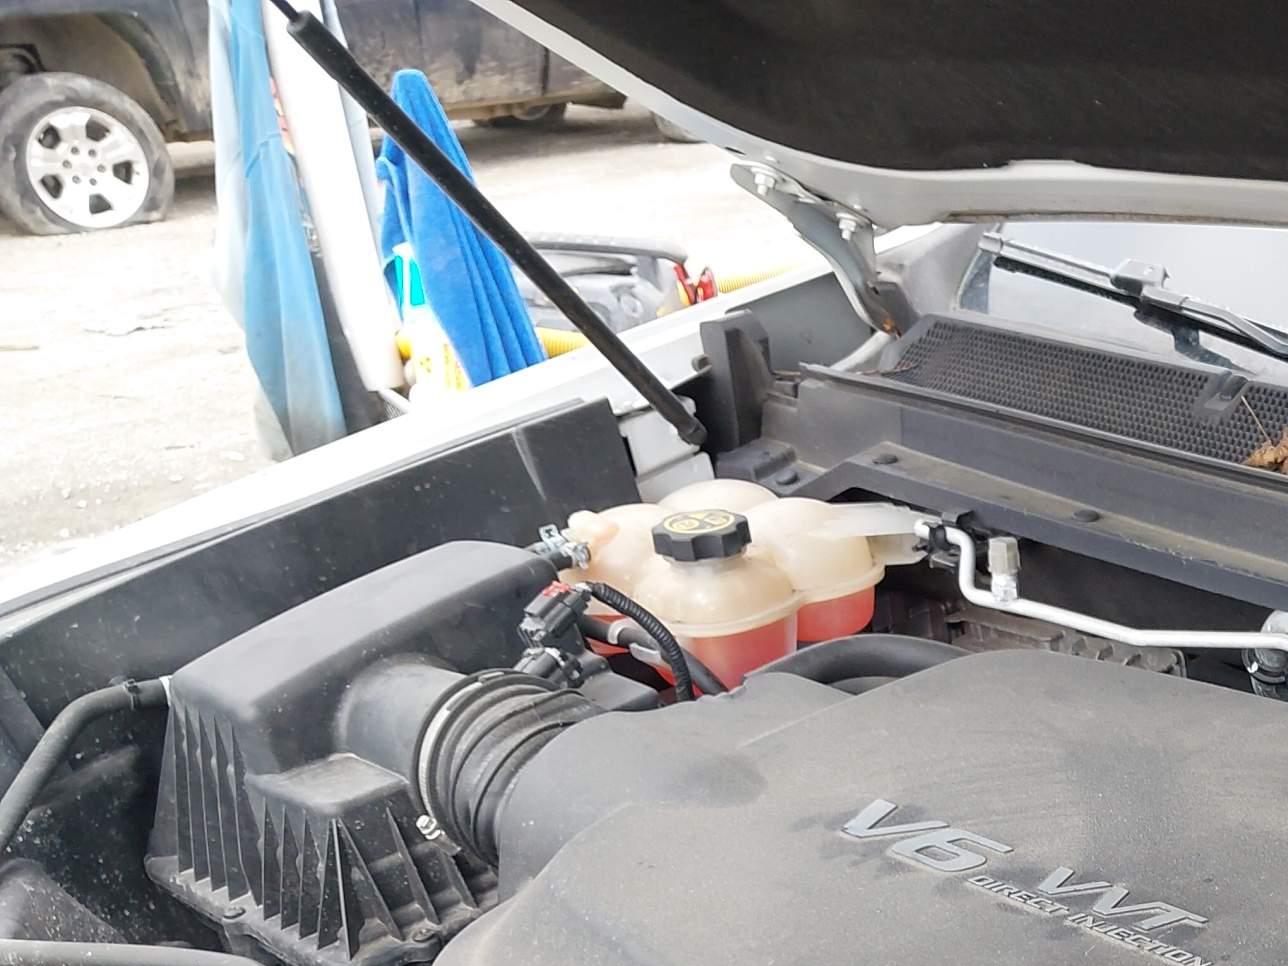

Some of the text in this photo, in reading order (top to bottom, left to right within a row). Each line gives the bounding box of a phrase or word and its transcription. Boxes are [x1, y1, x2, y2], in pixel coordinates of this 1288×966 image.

[841, 799, 1209, 931] V6 VVT
[966, 875, 1070, 915] DIRECT
